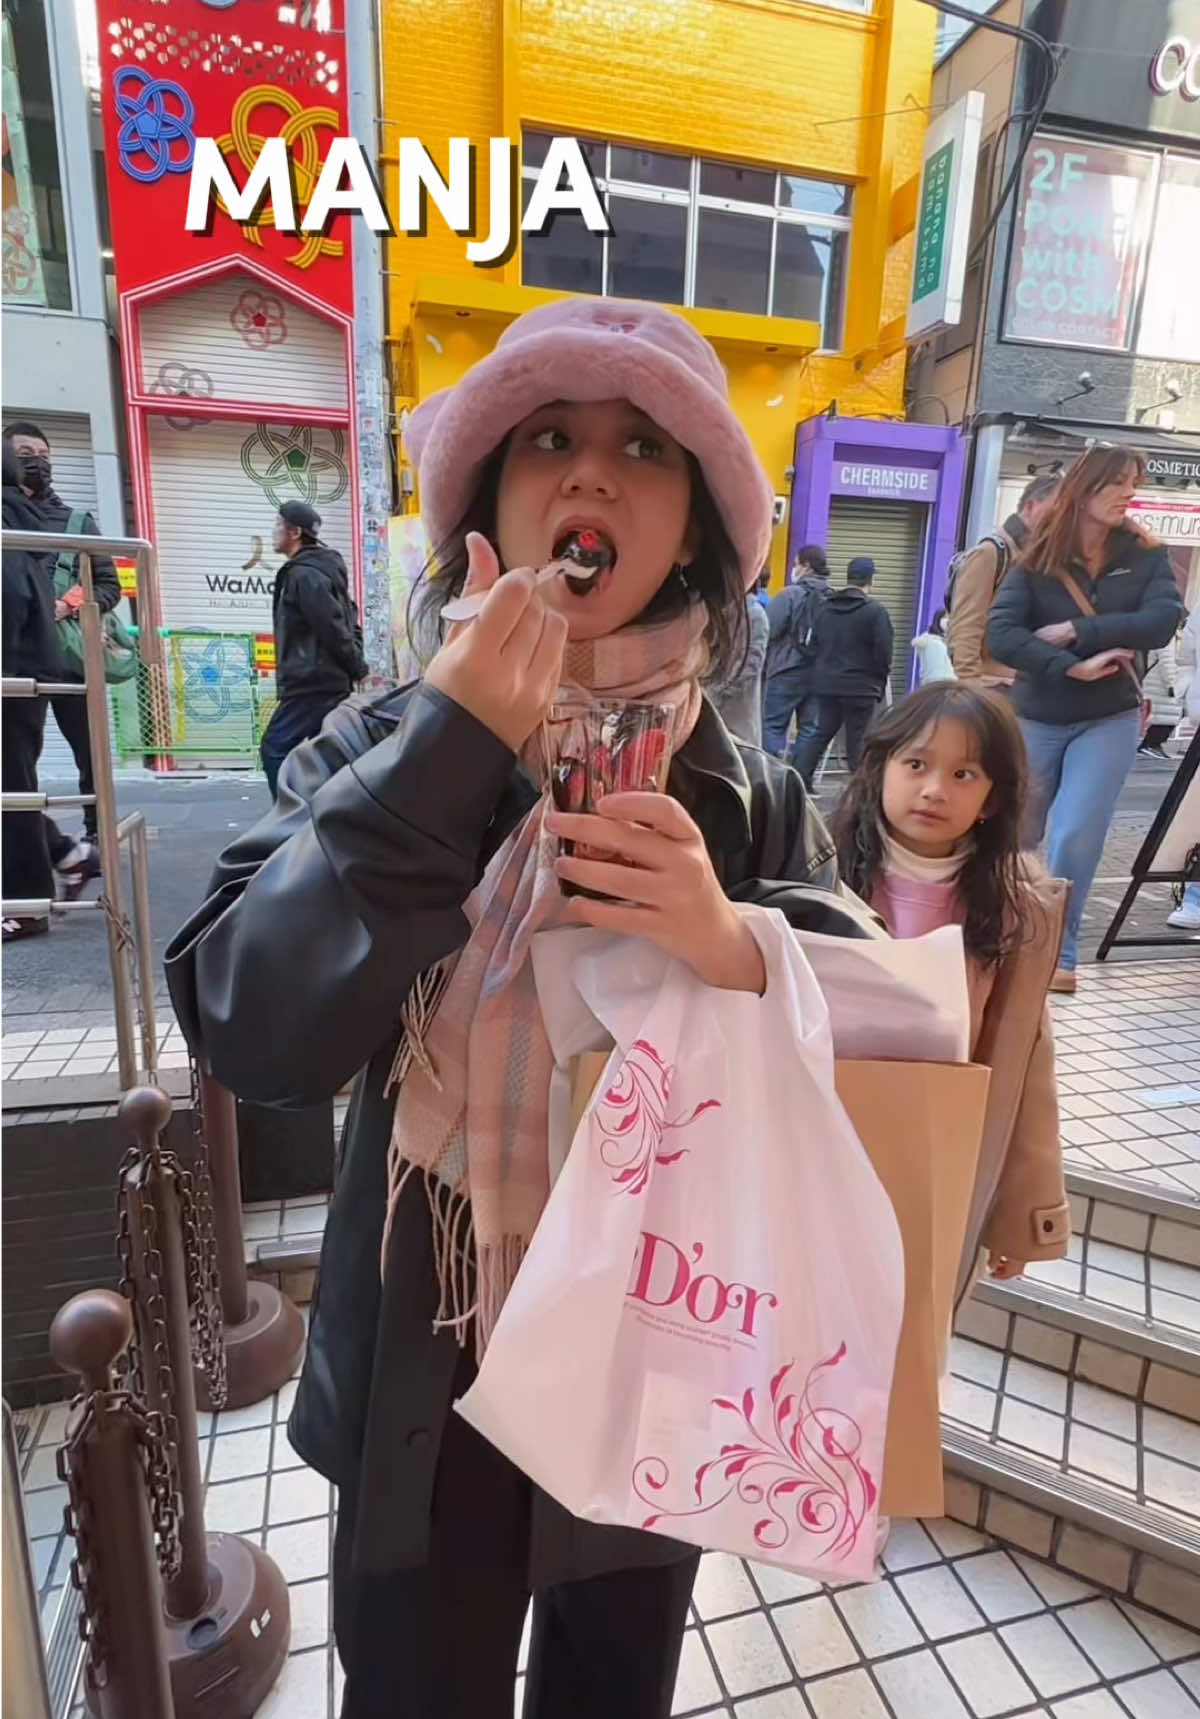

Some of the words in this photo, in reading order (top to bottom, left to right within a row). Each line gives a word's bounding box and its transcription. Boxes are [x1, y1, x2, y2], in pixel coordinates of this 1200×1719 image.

[1030, 146, 1088, 193] 2F
[1021, 240, 1105, 282] with
[840, 466, 929, 490] CHERMSIDE
